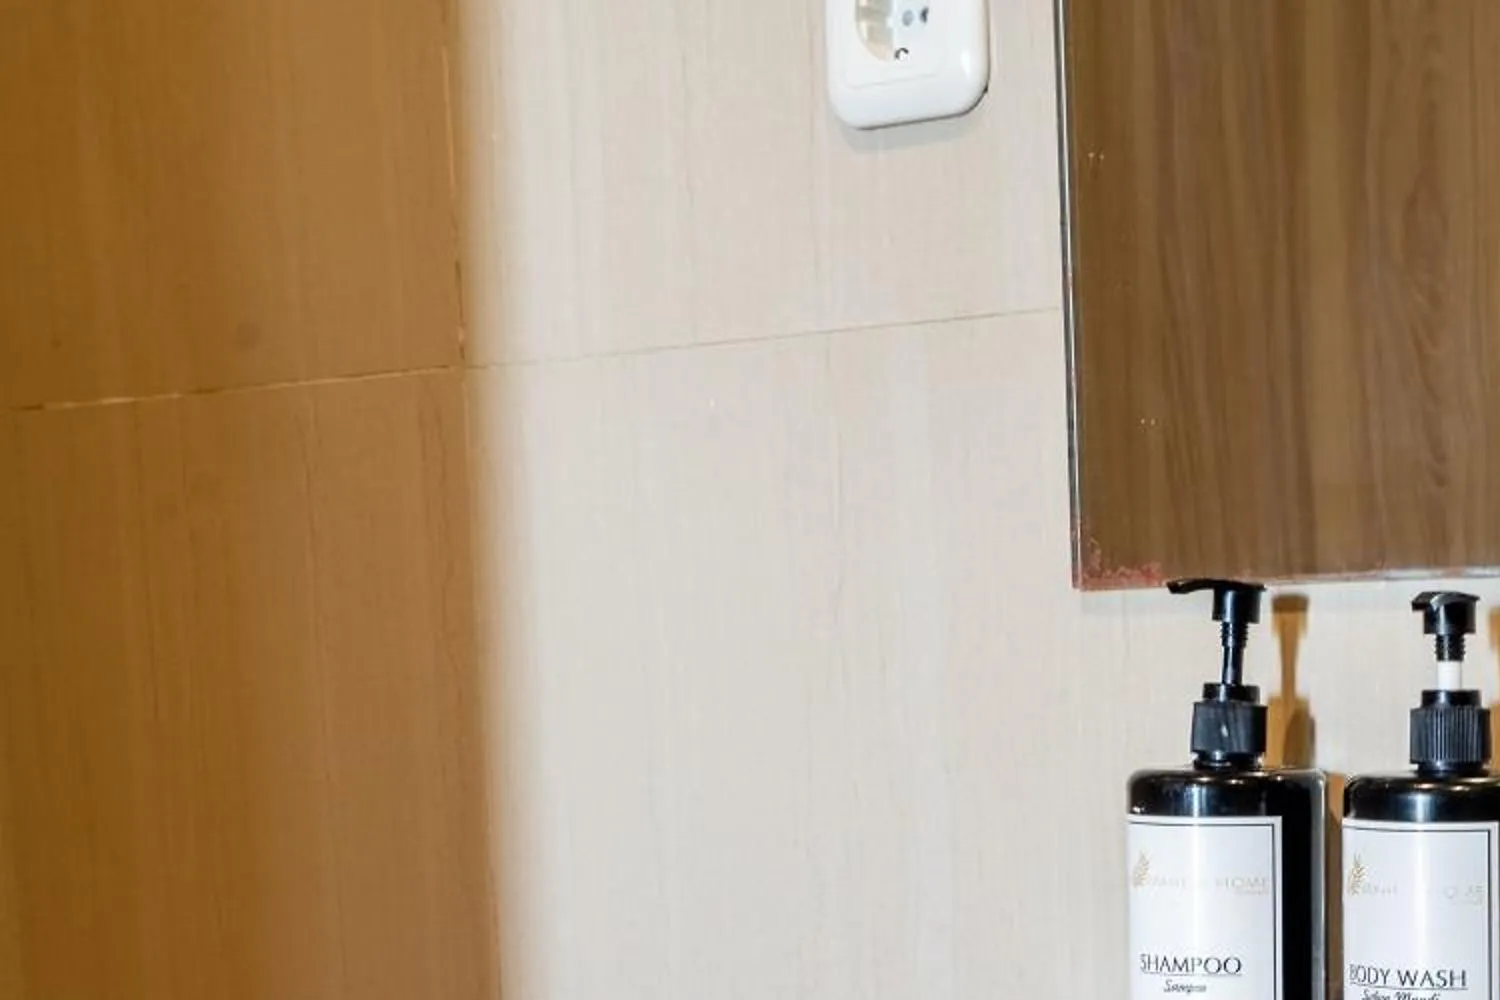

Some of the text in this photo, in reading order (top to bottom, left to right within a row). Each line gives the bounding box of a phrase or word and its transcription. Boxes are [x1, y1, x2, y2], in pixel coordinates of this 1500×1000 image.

[1140, 953, 1242, 975] SHAMPOO
[1349, 963, 1467, 988] BODY WASH
